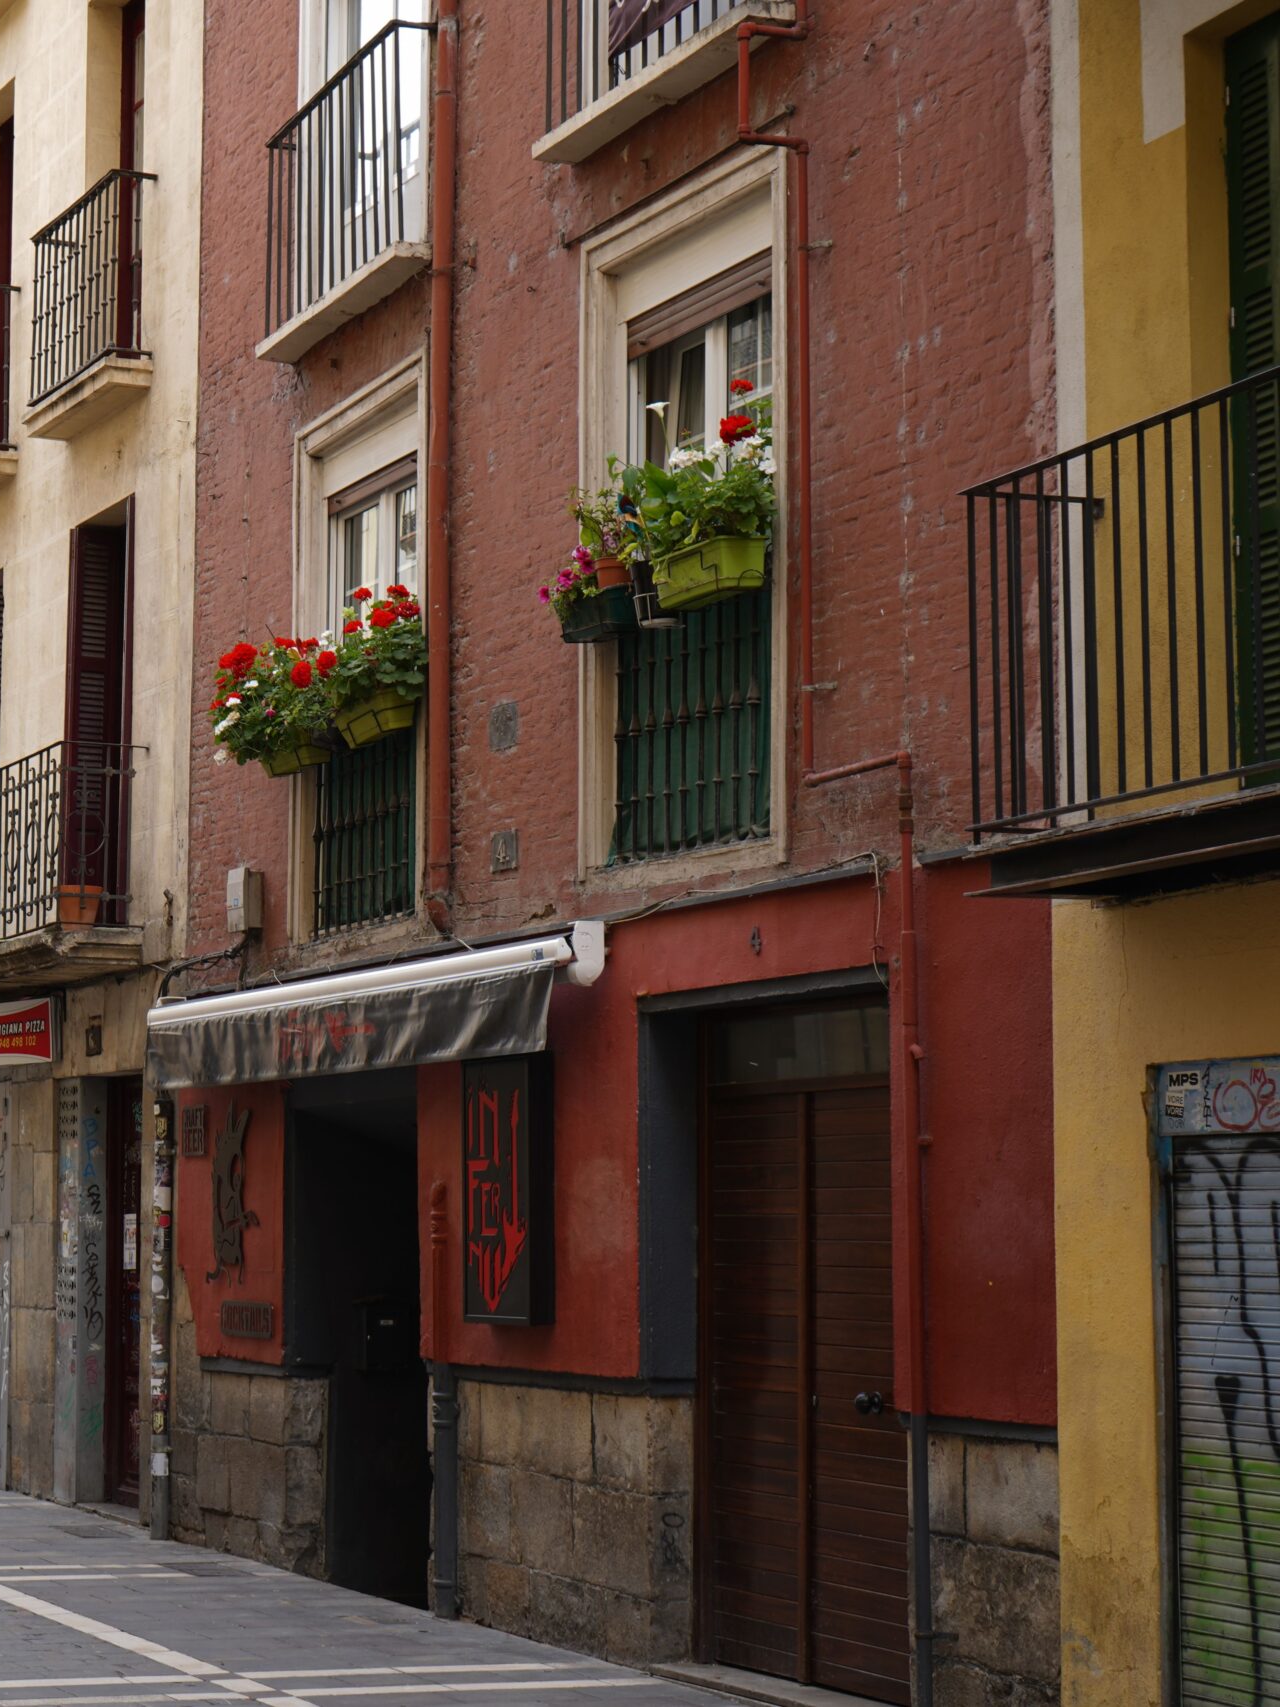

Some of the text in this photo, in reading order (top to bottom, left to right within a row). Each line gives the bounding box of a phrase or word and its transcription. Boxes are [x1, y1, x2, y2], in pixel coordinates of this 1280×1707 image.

[495, 838, 510, 863] 4
[750, 926, 763, 956] 4
[25, 1019, 45, 1033] PIZZA
[25, 1035, 37, 1046] 102
[1168, 1072, 1199, 1087] MPS
[1166, 1106, 1183, 1117] VORE
